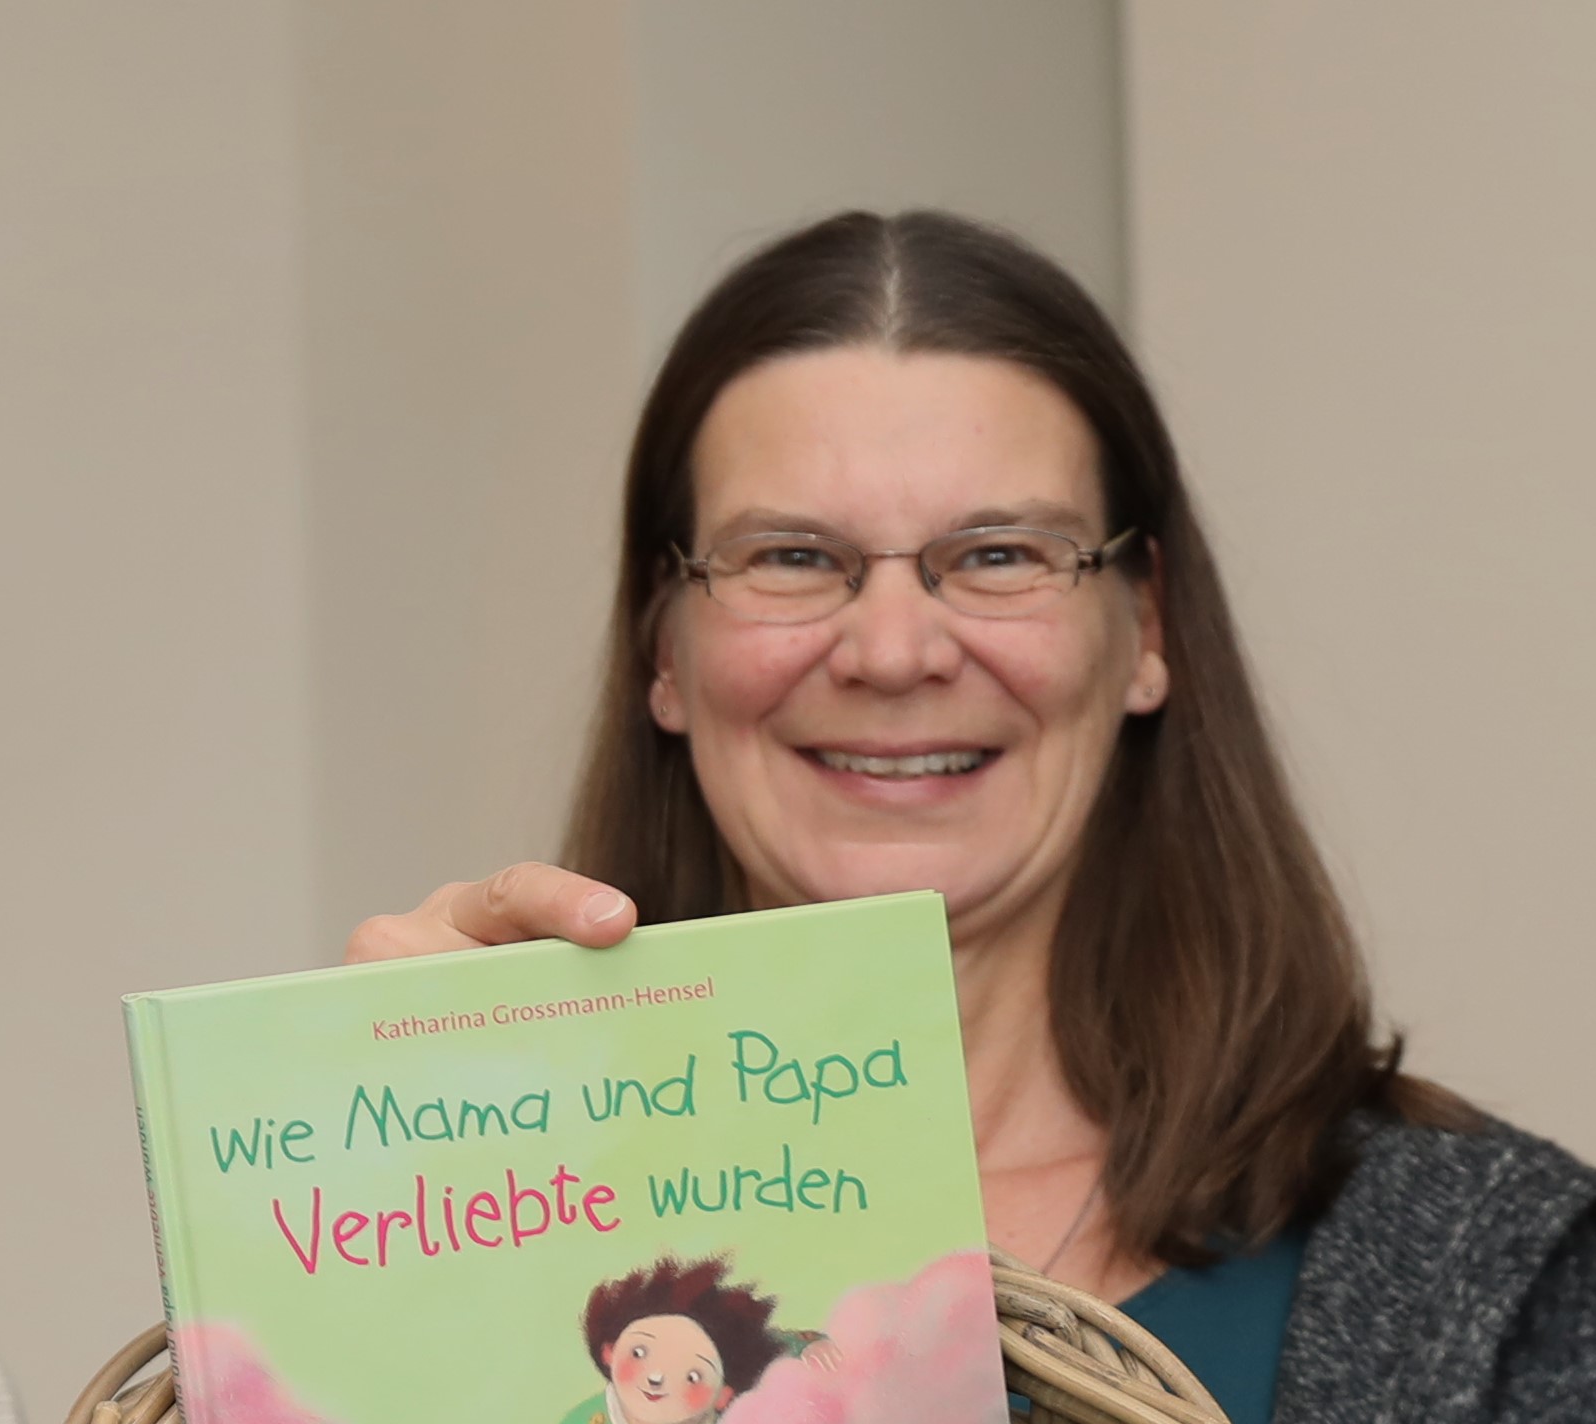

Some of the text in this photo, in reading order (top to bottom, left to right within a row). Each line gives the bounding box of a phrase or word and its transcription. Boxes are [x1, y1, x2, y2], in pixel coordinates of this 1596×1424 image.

[371, 977, 716, 1042] Katharina Grossmann-Hensel
[345, 1084, 550, 1150] Mama
[582, 1053, 697, 1124] und
[728, 1029, 909, 1125] Papa
[271, 1143, 868, 1275] Verliebte wurden
